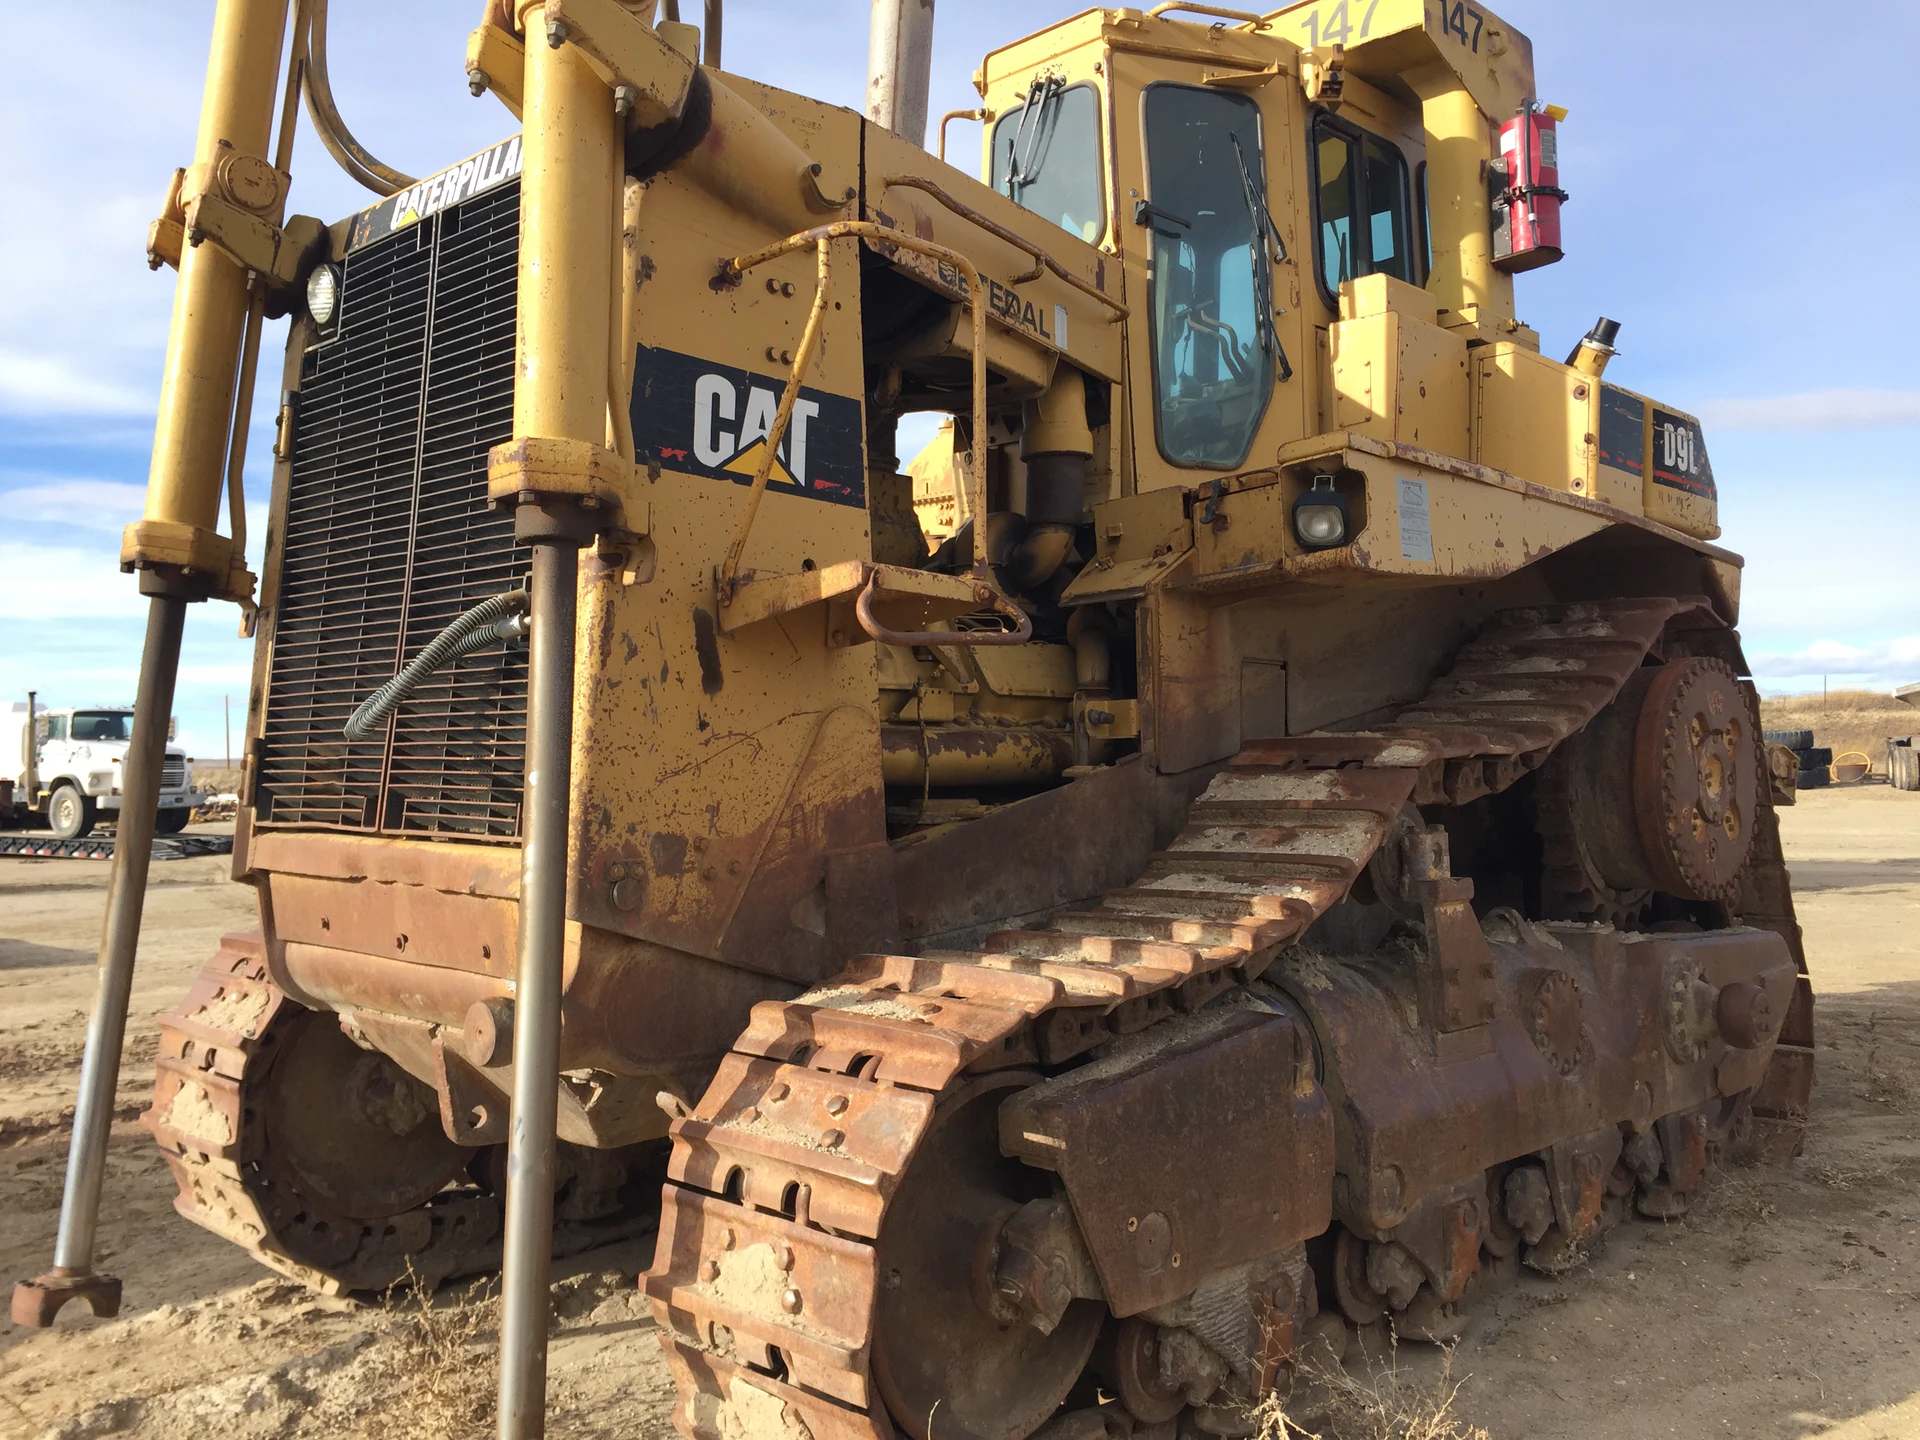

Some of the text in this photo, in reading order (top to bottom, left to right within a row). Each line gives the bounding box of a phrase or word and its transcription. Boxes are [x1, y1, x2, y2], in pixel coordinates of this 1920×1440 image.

[1301, 0, 1380, 47] 147
[1439, 0, 1484, 54] 147
[693, 373, 820, 487] CAT
[1663, 422, 1699, 476] D9L
